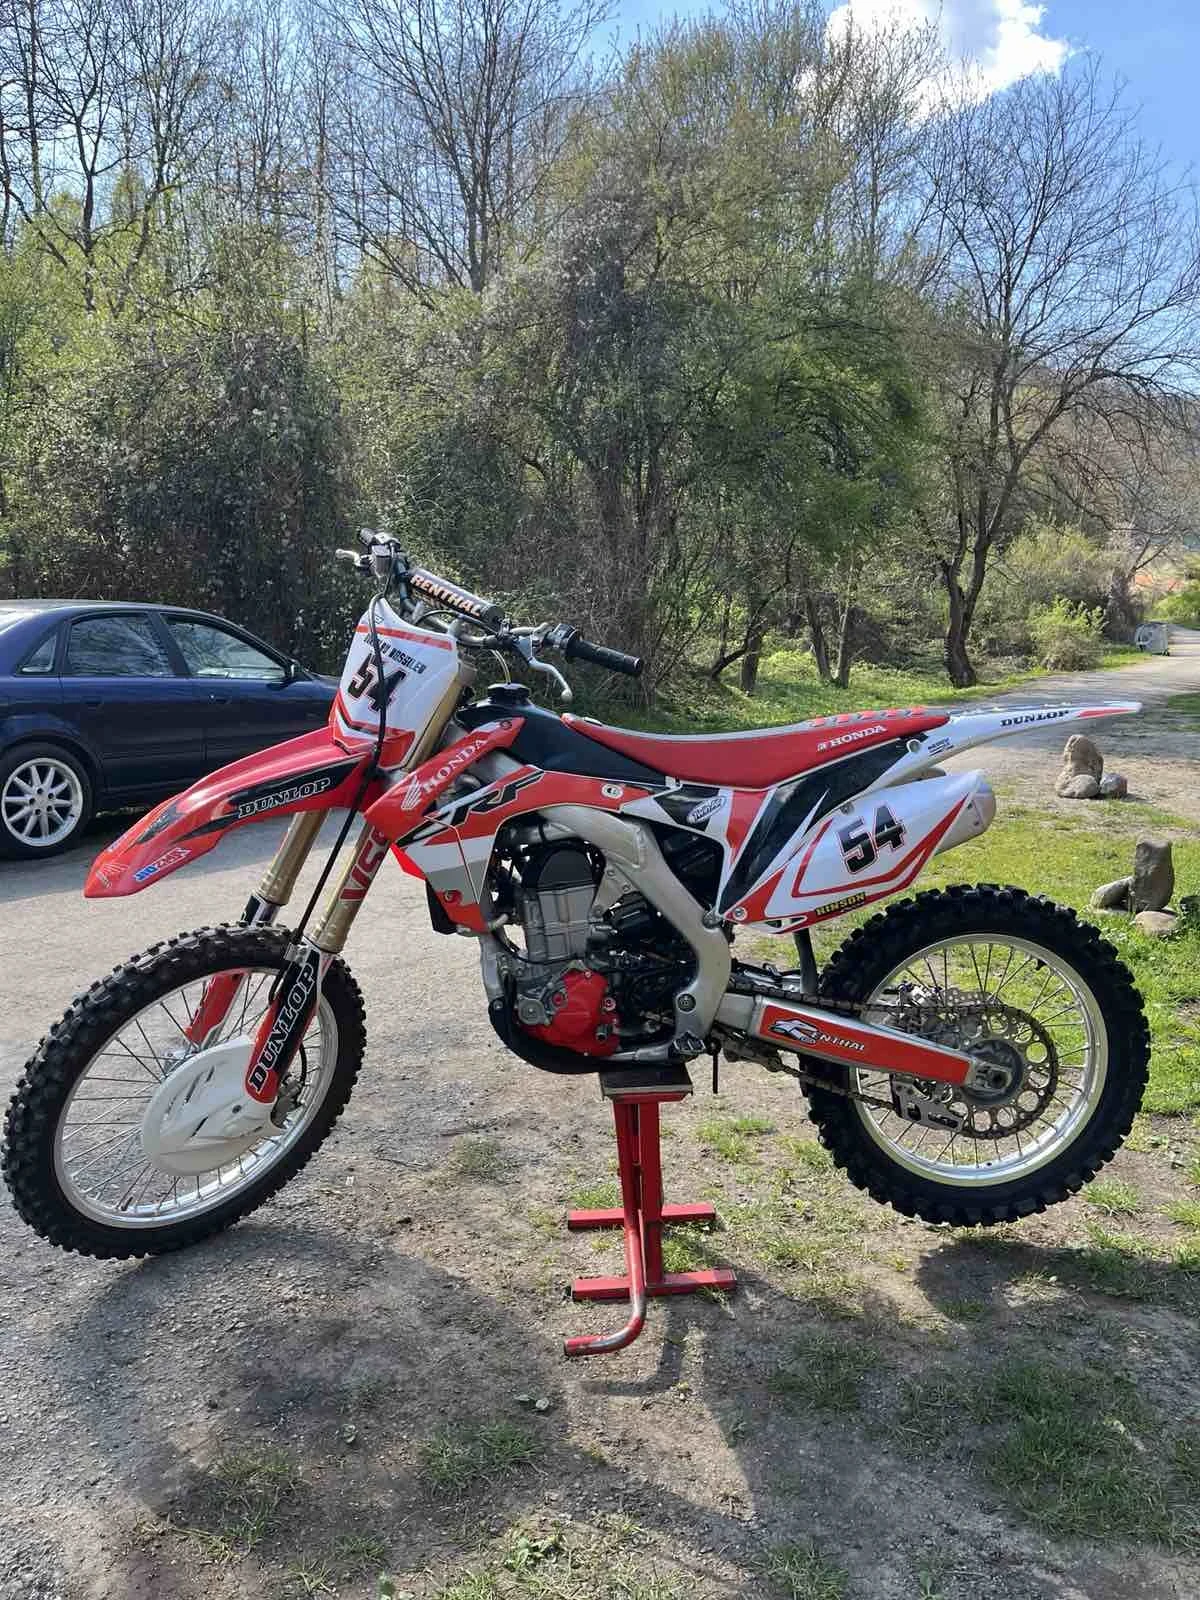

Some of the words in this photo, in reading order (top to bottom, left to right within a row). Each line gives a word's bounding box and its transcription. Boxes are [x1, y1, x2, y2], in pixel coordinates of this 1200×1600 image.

[410, 574, 481, 618] RENTHAL
[348, 652, 408, 713] 54
[829, 725, 888, 748] HONDA
[1001, 710, 1069, 727] DUNLOP
[422, 738, 489, 794] HONDA
[238, 777, 331, 820] DUNLOP
[836, 803, 906, 875] 54
[249, 962, 315, 1095] DUNLOP
